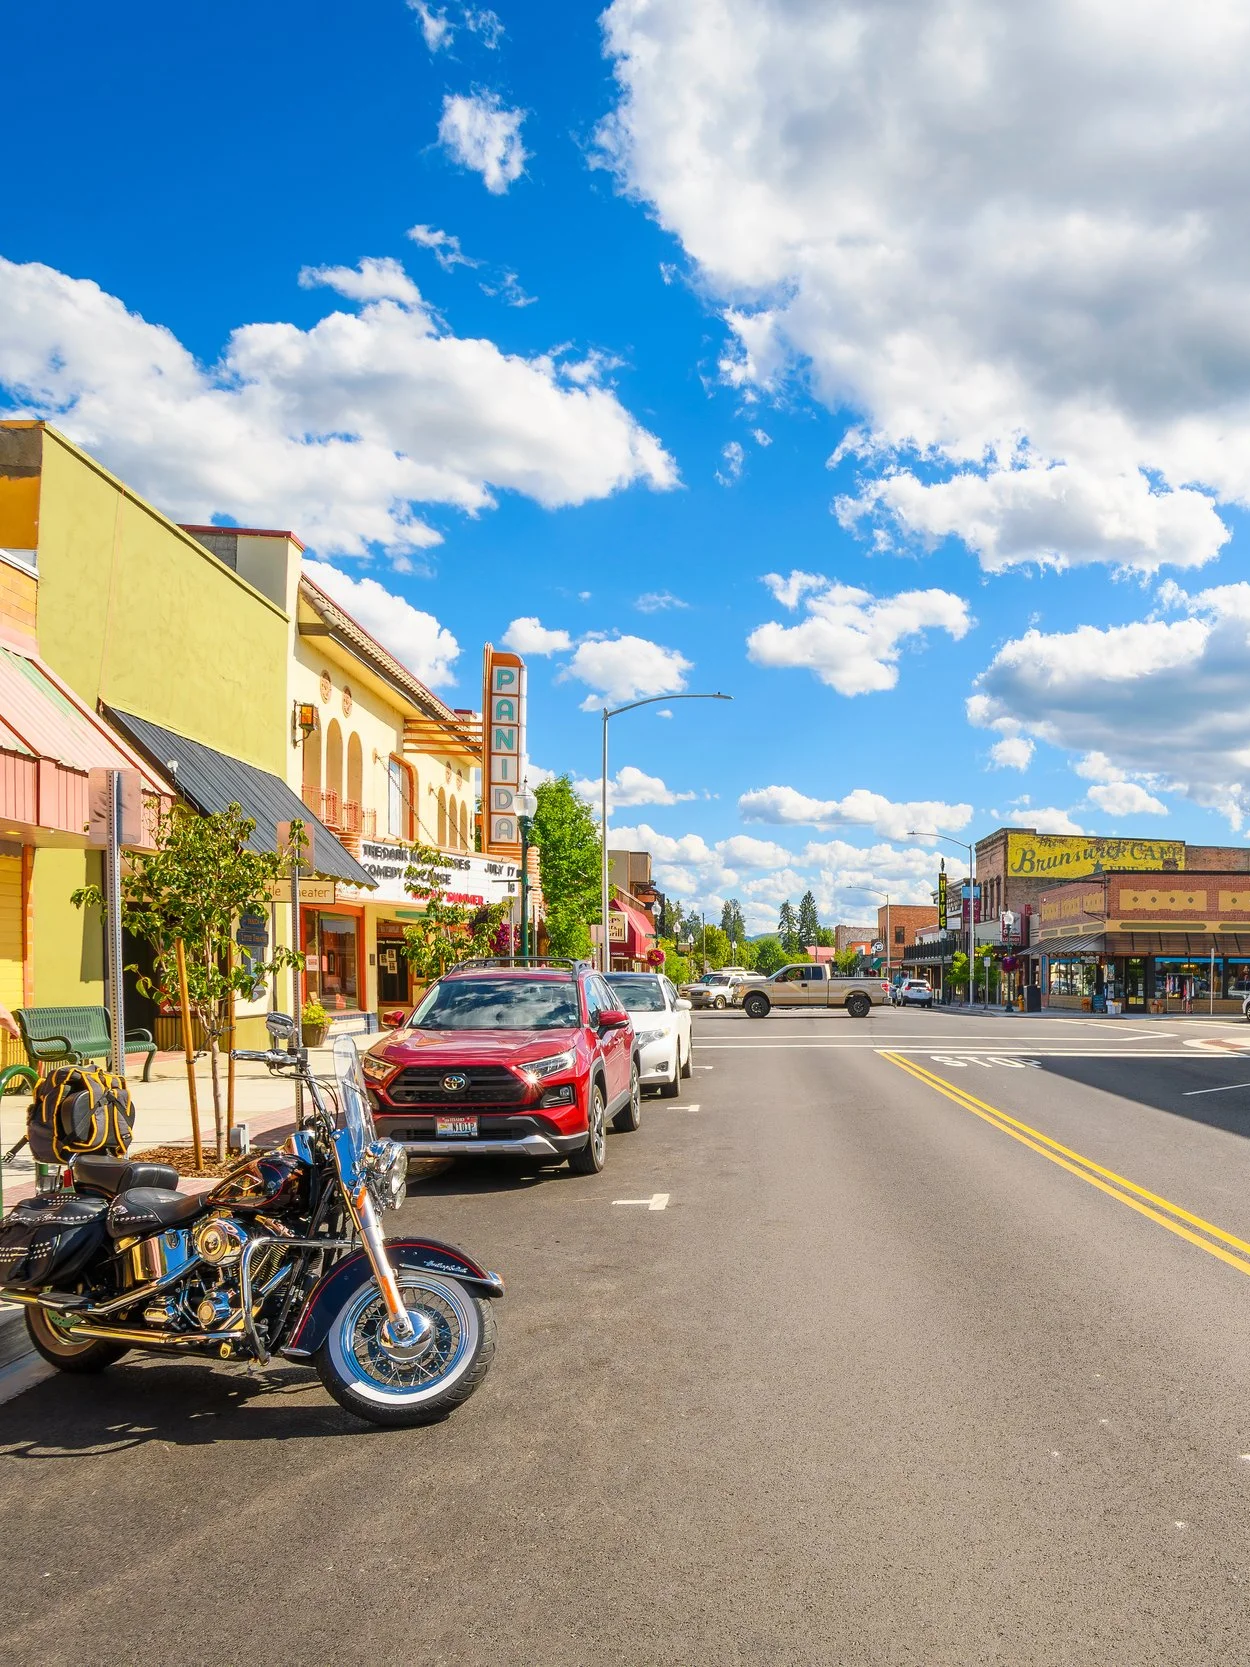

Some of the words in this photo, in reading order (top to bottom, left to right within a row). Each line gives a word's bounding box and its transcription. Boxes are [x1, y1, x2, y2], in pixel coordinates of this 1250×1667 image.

[495, 669, 515, 840] PANIDA
[362, 843, 383, 859] THE
[382, 846, 409, 862] DARK
[484, 863, 504, 878] JULY
[507, 866, 516, 878] 17
[446, 891, 484, 905] SUMMER
[939, 880, 947, 927] HIVE
[930, 1055, 1042, 1069] STOP
